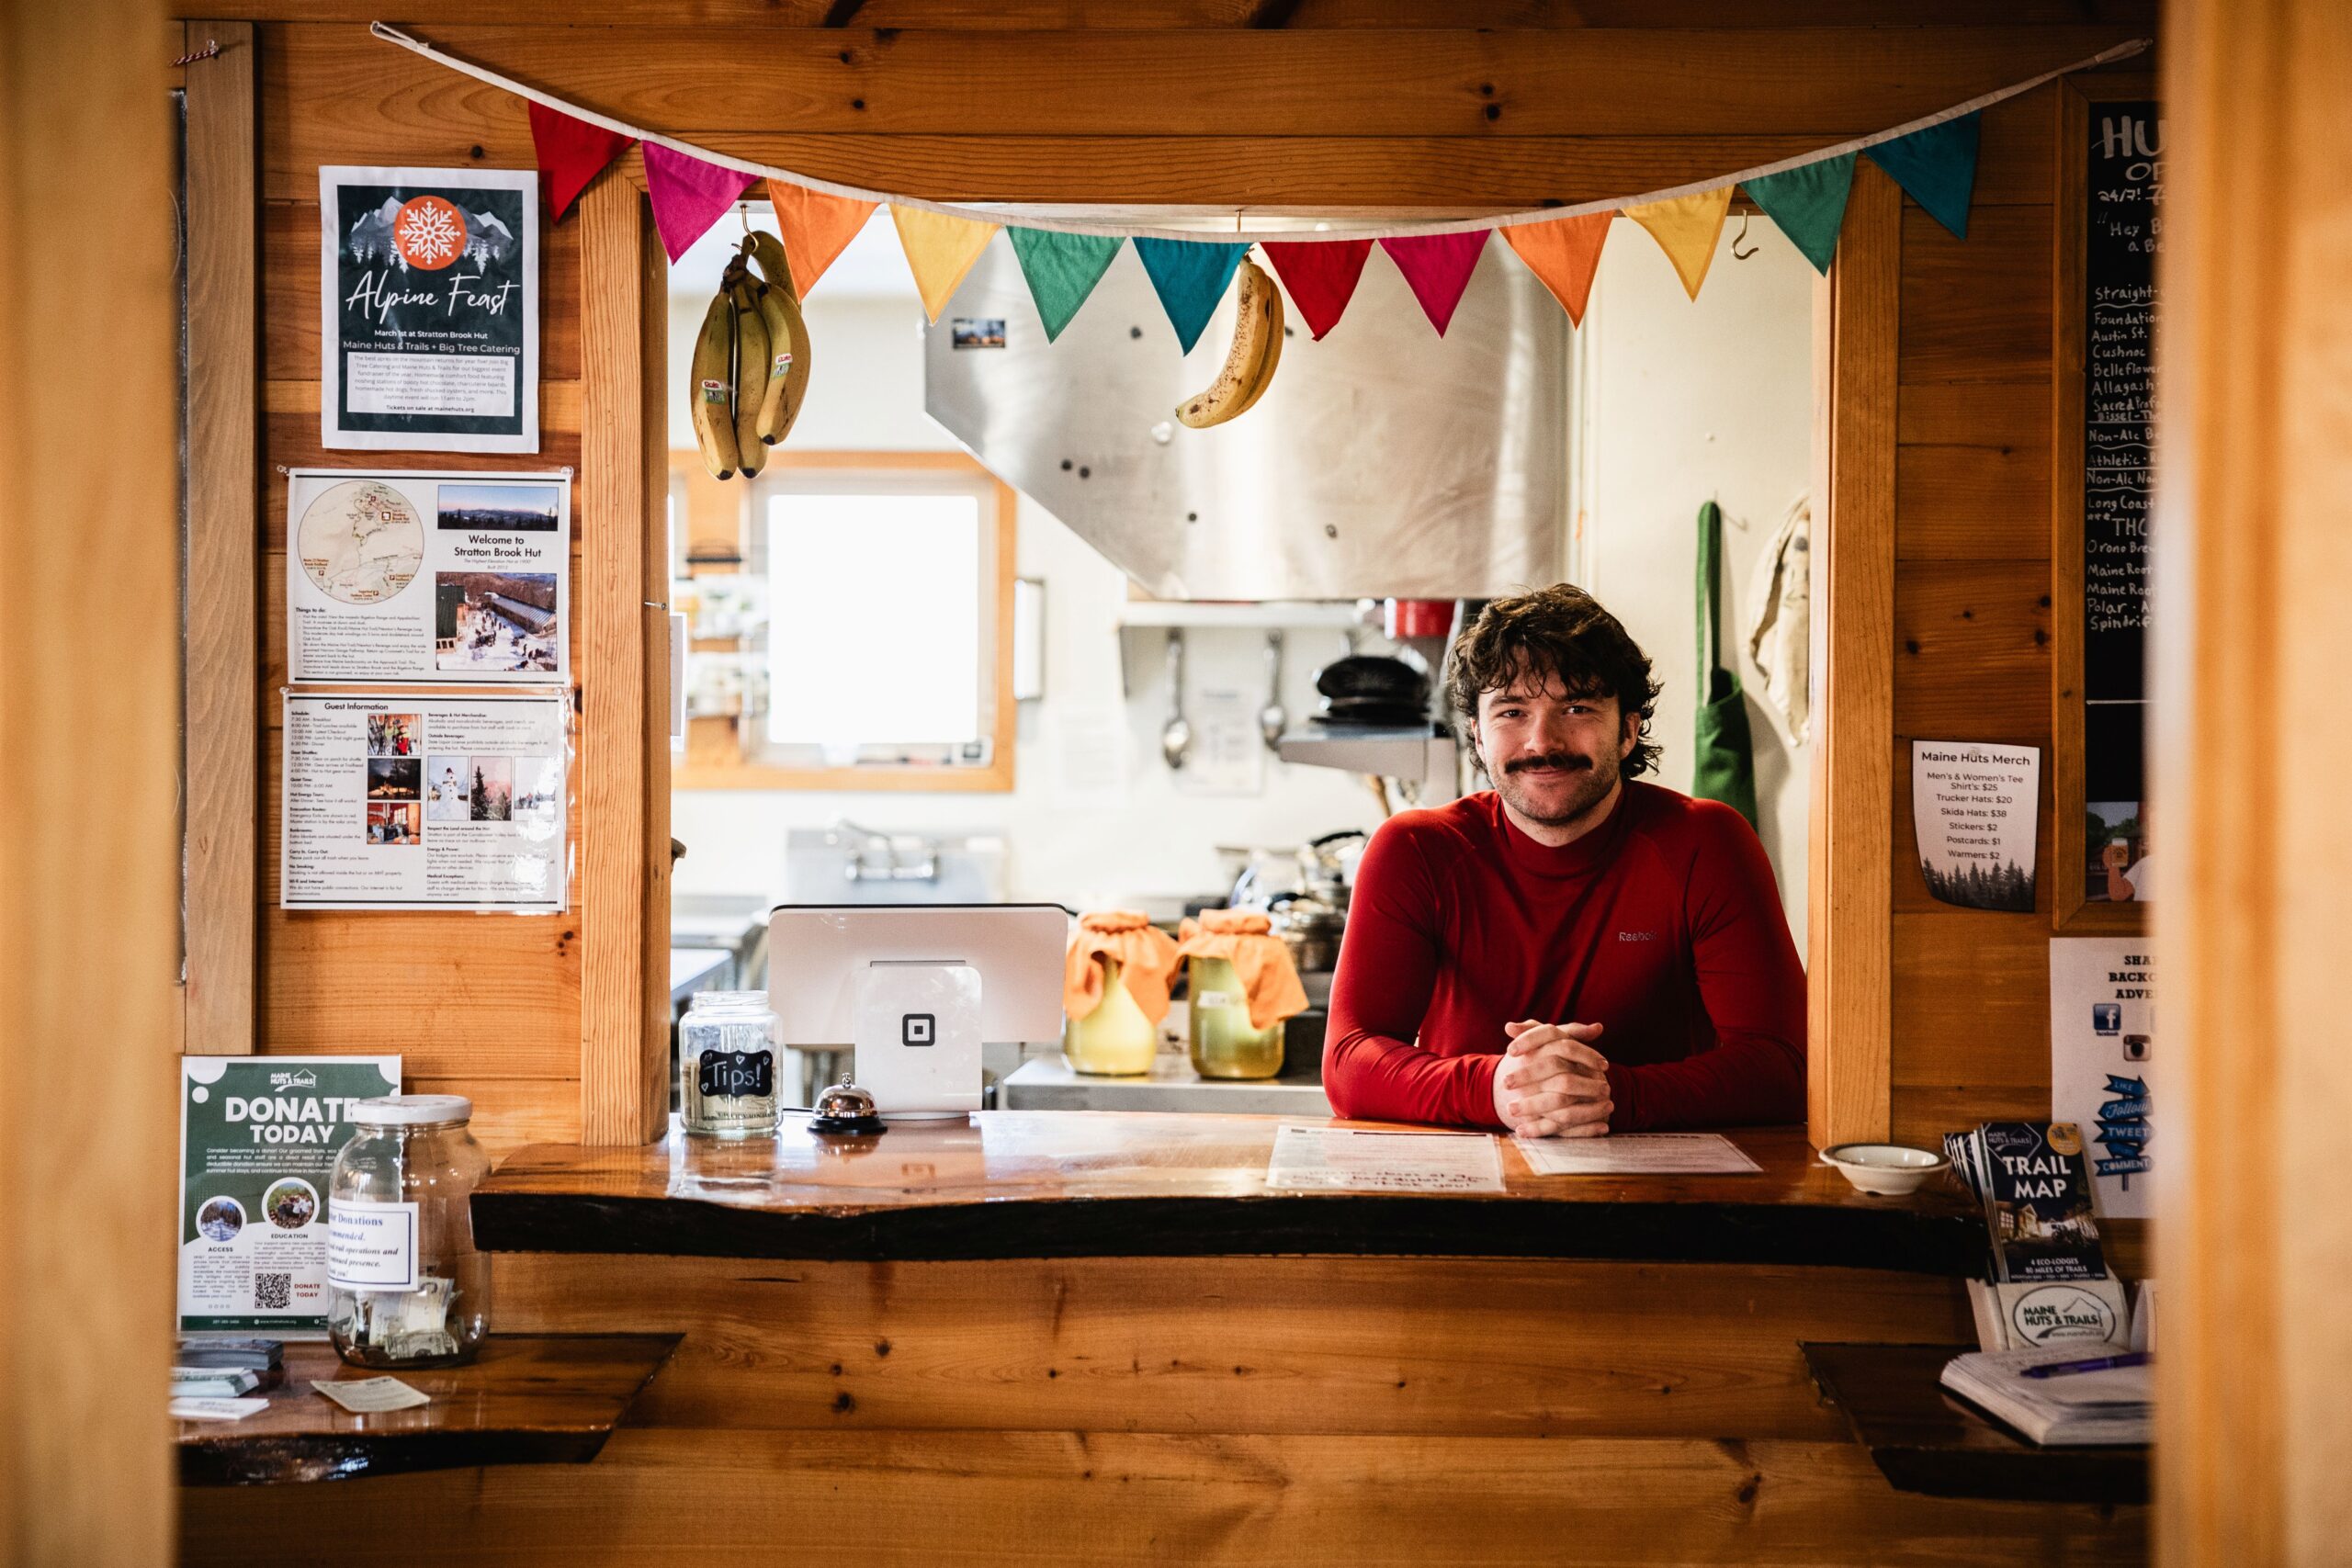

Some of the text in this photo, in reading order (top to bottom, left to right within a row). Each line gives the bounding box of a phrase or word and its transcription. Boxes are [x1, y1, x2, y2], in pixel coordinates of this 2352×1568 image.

[345, 269, 521, 324] Alpine Feast
[2091, 326, 2147, 342] Austin St.
[344, 341, 371, 349] Maine
[375, 342, 395, 350] Huts
[406, 343, 429, 351] Trails
[439, 344, 455, 353] Big
[458, 344, 478, 352] Tree
[481, 344, 520, 355] Catering
[2092, 378, 2154, 396] Allagash
[2094, 399, 2134, 412] Sacred
[2089, 430, 2139, 442] Non-Alc
[2088, 453, 2140, 467] Athletic
[2087, 470, 2132, 485] Non-Alc
[2088, 497, 2117, 512] Long
[469, 535, 512, 544] Welcome
[455, 547, 541, 557] Stratton Brook Hut
[2087, 540, 2126, 553] Orono
[2088, 563, 2125, 576] Maine
[2086, 582, 2126, 595] Maine
[2087, 598, 2127, 614] Polar
[1921, 751, 2030, 765] Maine Huts Merch
[1963, 773, 2005, 782] Women's
[2007, 775, 2023, 784] Tee
[1937, 794, 1969, 802] Trucker
[1996, 795, 2012, 804] $20
[1950, 822, 1985, 830] Stickers:
[1947, 836, 1990, 845] Postcards:
[1948, 851, 2000, 860] Warmers: $2
[704, 1060, 762, 1093] Tips!
[2115, 1081, 2133, 1090] LIKE
[225, 1097, 360, 1122] DONATE
[250, 1125, 334, 1144] TODAY
[2109, 1127, 2150, 1136] TWEET
[2003, 1156, 2071, 1176] TRAIL
[2103, 1159, 2148, 1171] COMMENT
[2015, 1179, 2066, 1198] MAP
[2024, 1305, 2057, 1314] MAINE
[2025, 1314, 2098, 1325] HUTS & TRAILS
